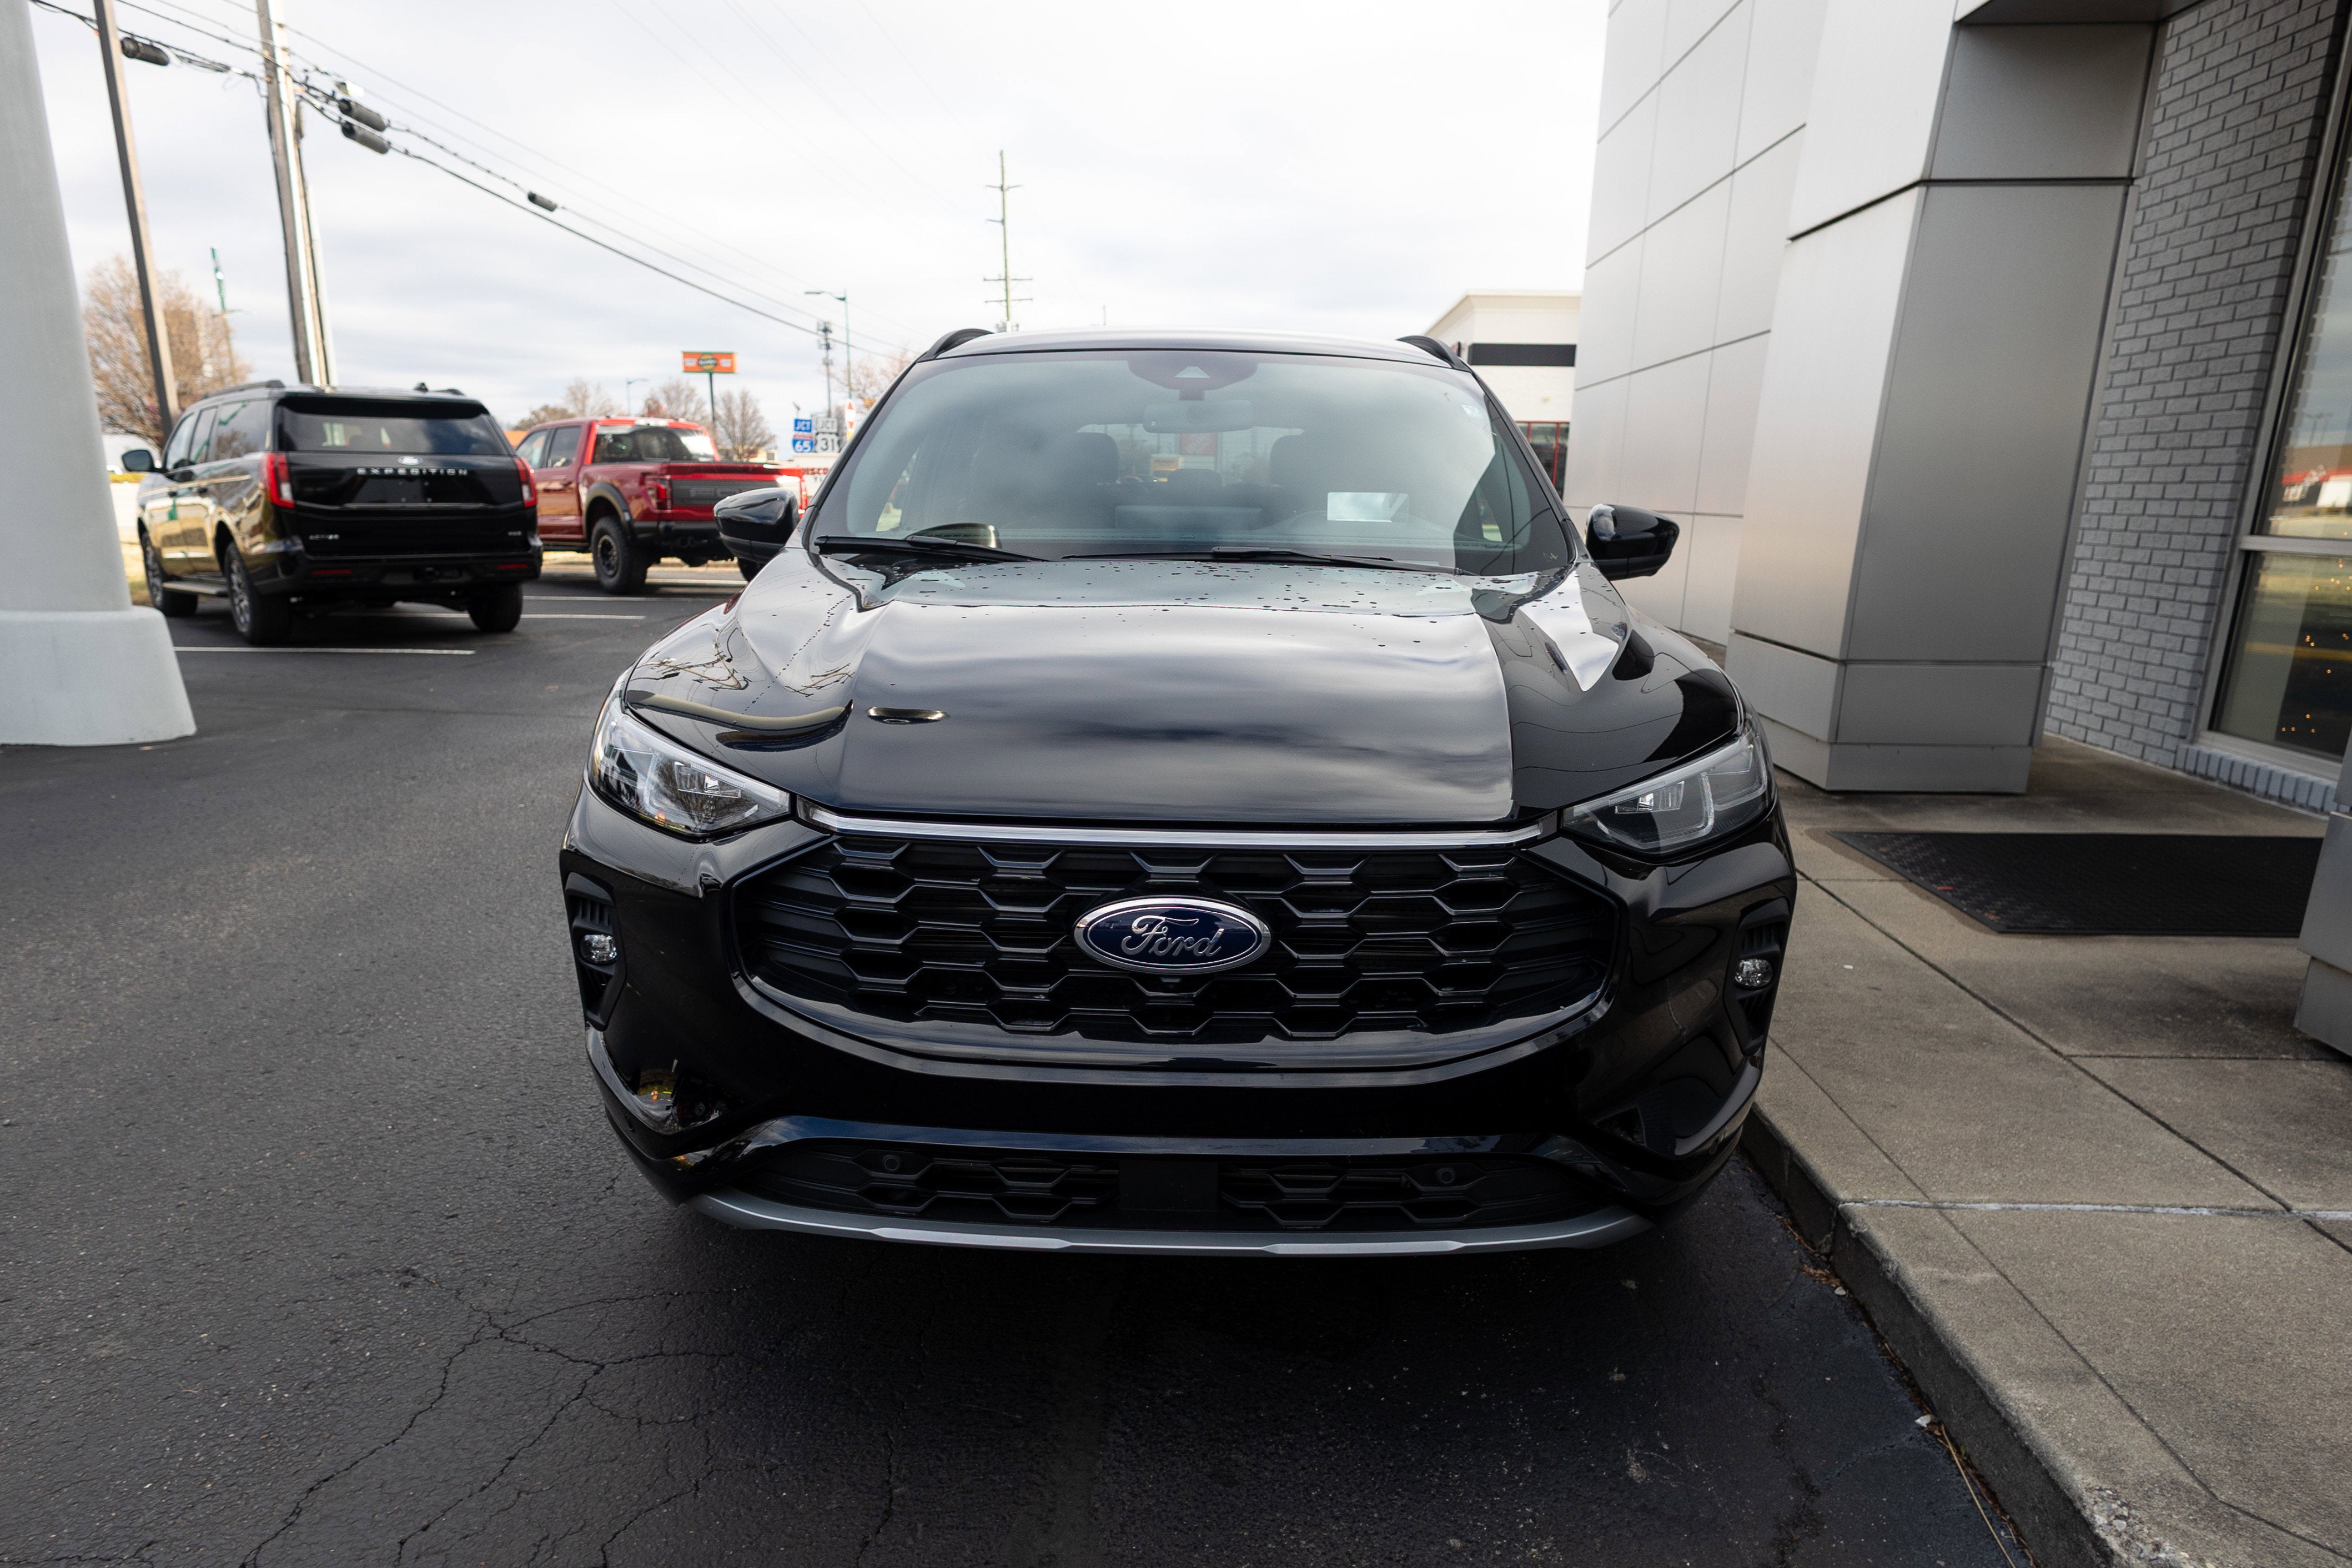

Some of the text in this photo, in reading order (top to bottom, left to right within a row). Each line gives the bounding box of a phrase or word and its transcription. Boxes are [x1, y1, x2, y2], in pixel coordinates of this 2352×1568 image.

[795, 420, 811, 431] JCT
[819, 420, 836, 429] JCT
[795, 440, 811, 453] 65
[821, 438, 835, 451] 31
[357, 468, 468, 476] EXPEDITION
[1120, 914, 1225, 957] Ford
